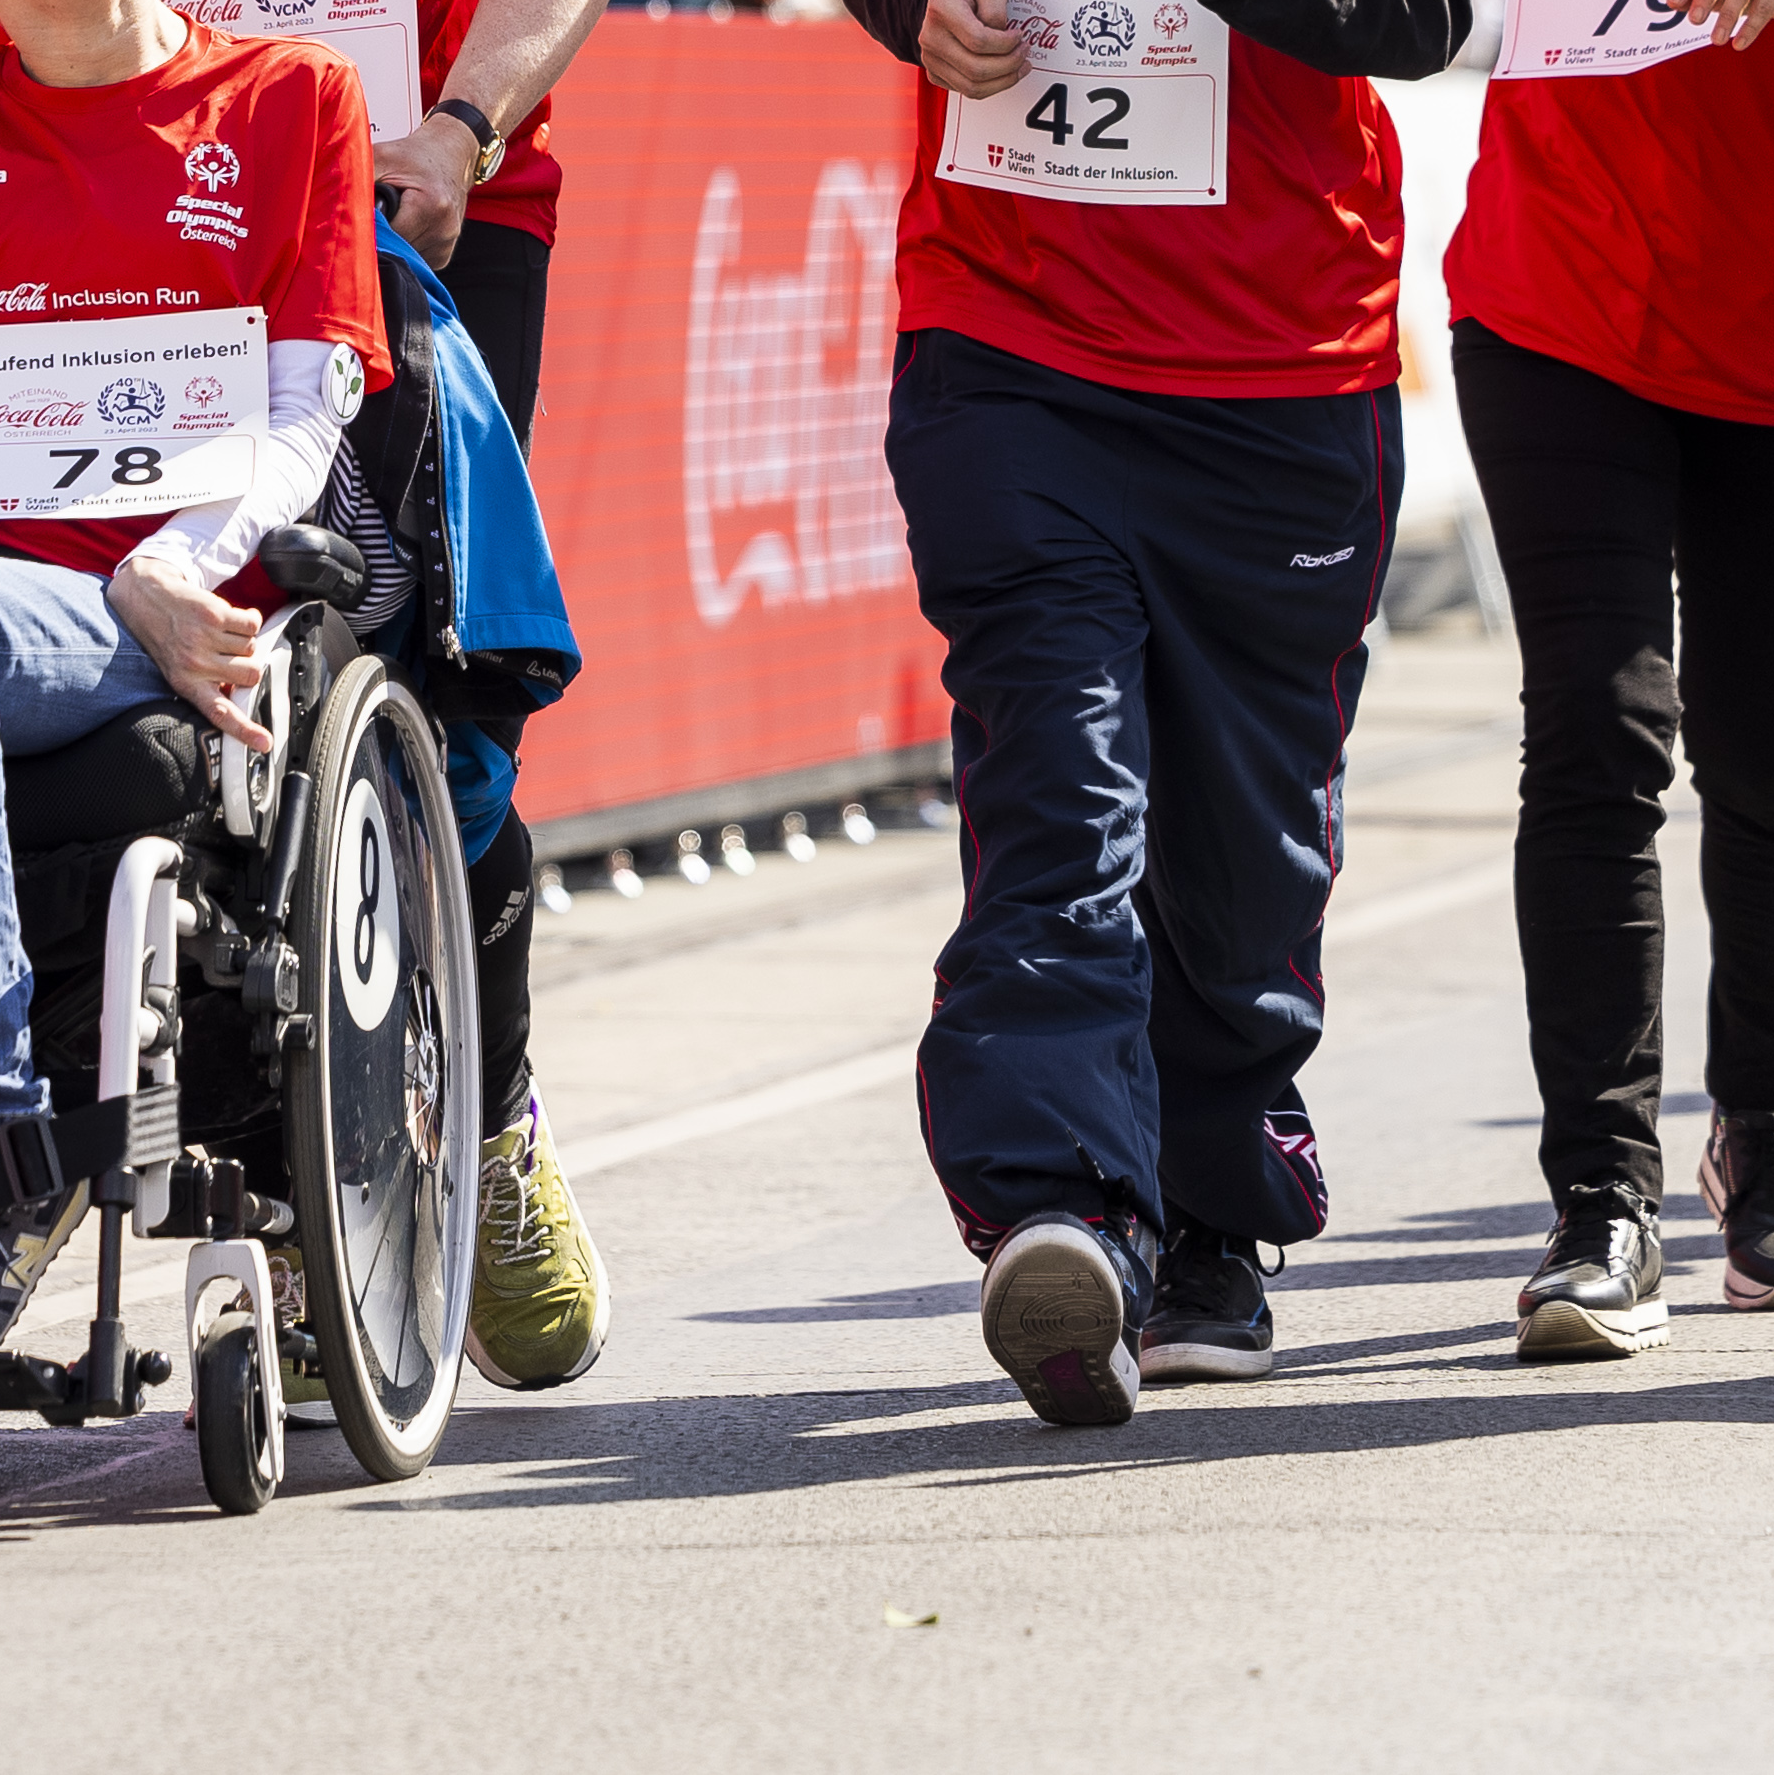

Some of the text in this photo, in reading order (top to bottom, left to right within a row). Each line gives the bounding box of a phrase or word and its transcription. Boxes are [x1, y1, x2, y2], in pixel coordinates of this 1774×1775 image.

[273, 2, 307, 17] VCM
[327, 5, 387, 20] Olympics
[276, 20, 294, 29] April
[296, 17, 314, 26] 2023
[1088, 44, 1121, 57] VCM
[1147, 44, 1192, 55] Special
[1567, 46, 1595, 57] Stadt
[1603, 47, 1638, 59] Stadt
[1641, 44, 1662, 56] der
[1089, 59, 1106, 68] April
[1107, 60, 1127, 68] 2023
[1141, 54, 1197, 67] Olympics
[1565, 56, 1594, 65] Wien
[1025, 82, 1131, 150] 42
[1008, 148, 1035, 164] Stadt
[1007, 161, 1035, 175] Wien
[1044, 161, 1178, 180] Stadt der Inklusion.
[175, 194, 244, 219] Special
[166, 210, 248, 238] Olympics
[179, 224, 237, 252] Österreich
[52, 288, 149, 309] Inclusion
[156, 287, 200, 305] Run
[62, 349, 155, 367] Inklusion
[163, 340, 248, 361] erleben!
[8, 387, 68, 402] MITEINAND
[116, 415, 151, 426] VCM
[179, 411, 229, 422] Special
[172, 420, 235, 431] Olympics
[3, 429, 72, 438] ÖSTERREICH
[49, 446, 163, 490] 78
[25, 503, 60, 511] Wien
[26, 497, 59, 505] Stadt
[71, 497, 110, 507] Stadt
[115, 496, 138, 505] der
[354, 816, 380, 986] 8
